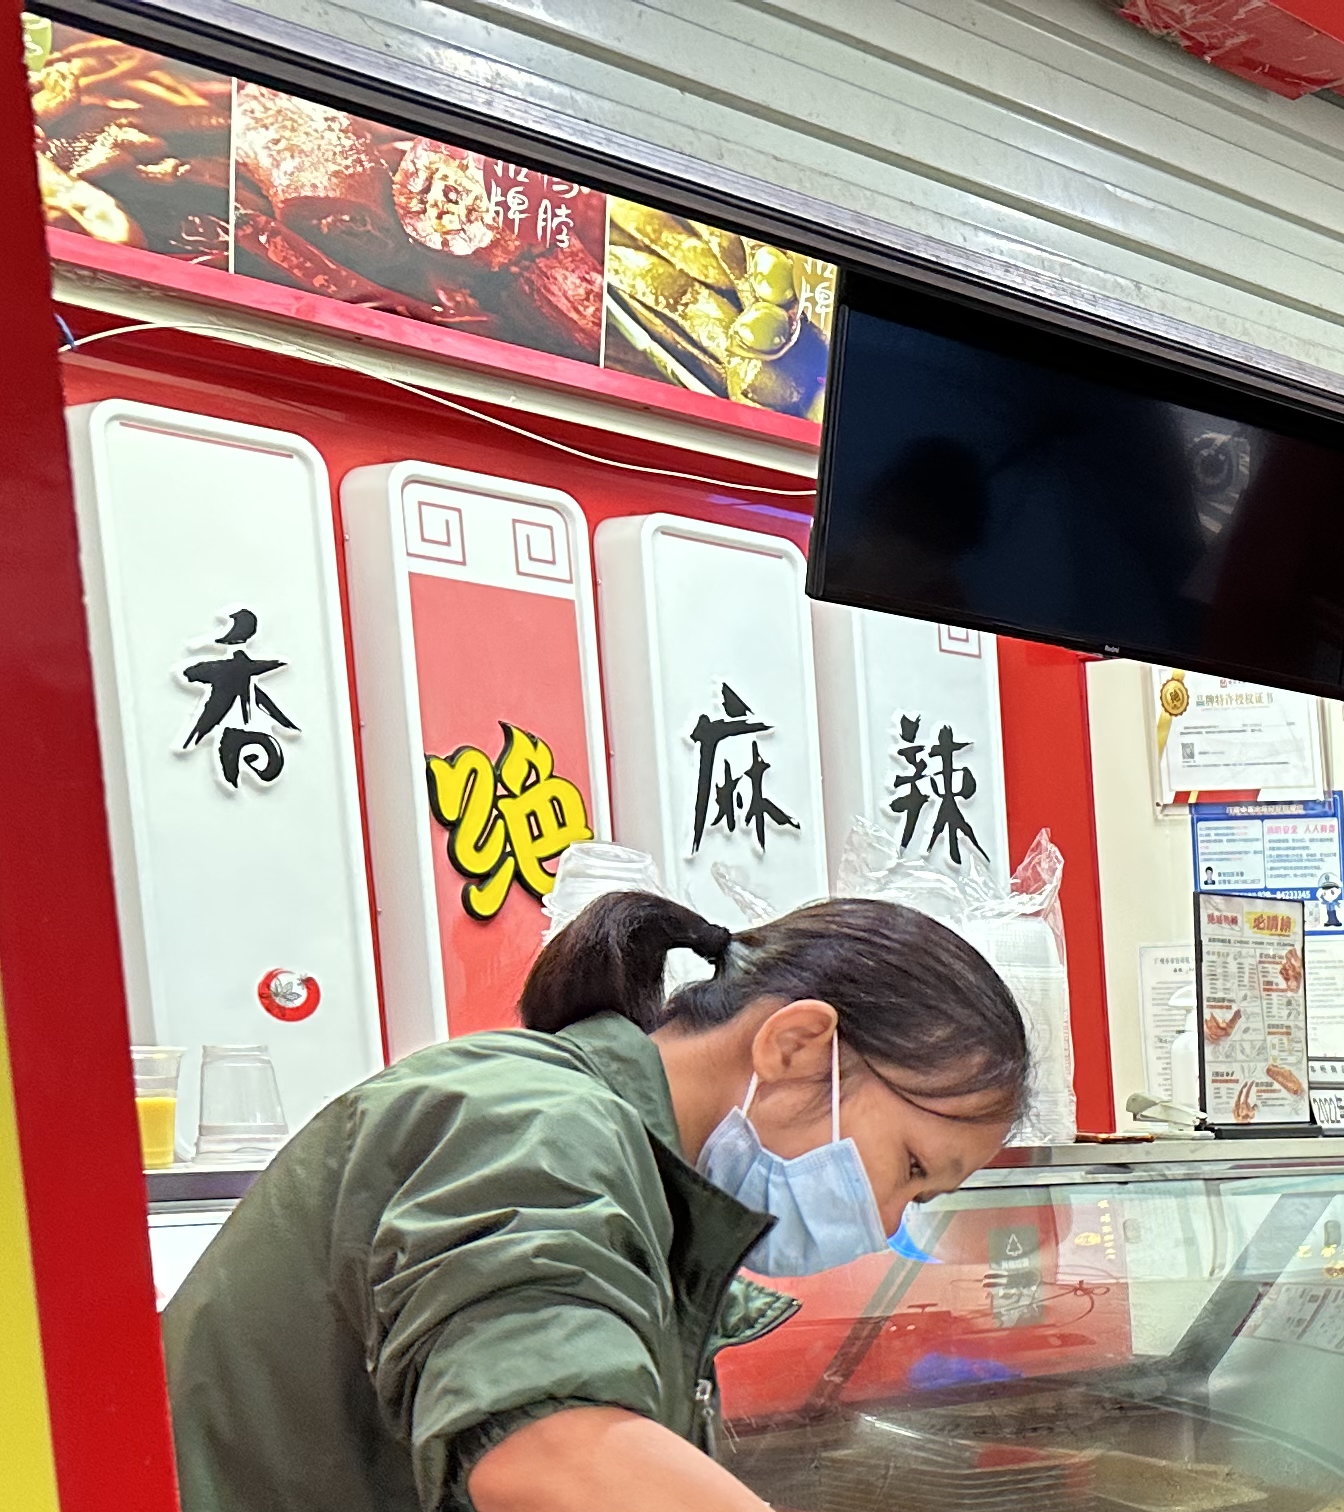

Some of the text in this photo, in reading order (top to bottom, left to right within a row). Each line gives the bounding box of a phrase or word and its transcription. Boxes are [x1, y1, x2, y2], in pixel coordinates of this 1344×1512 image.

[183, 608, 302, 788] 香
[690, 682, 801, 854] 麻
[426, 719, 595, 922] 绝
[890, 714, 990, 865] 辣
